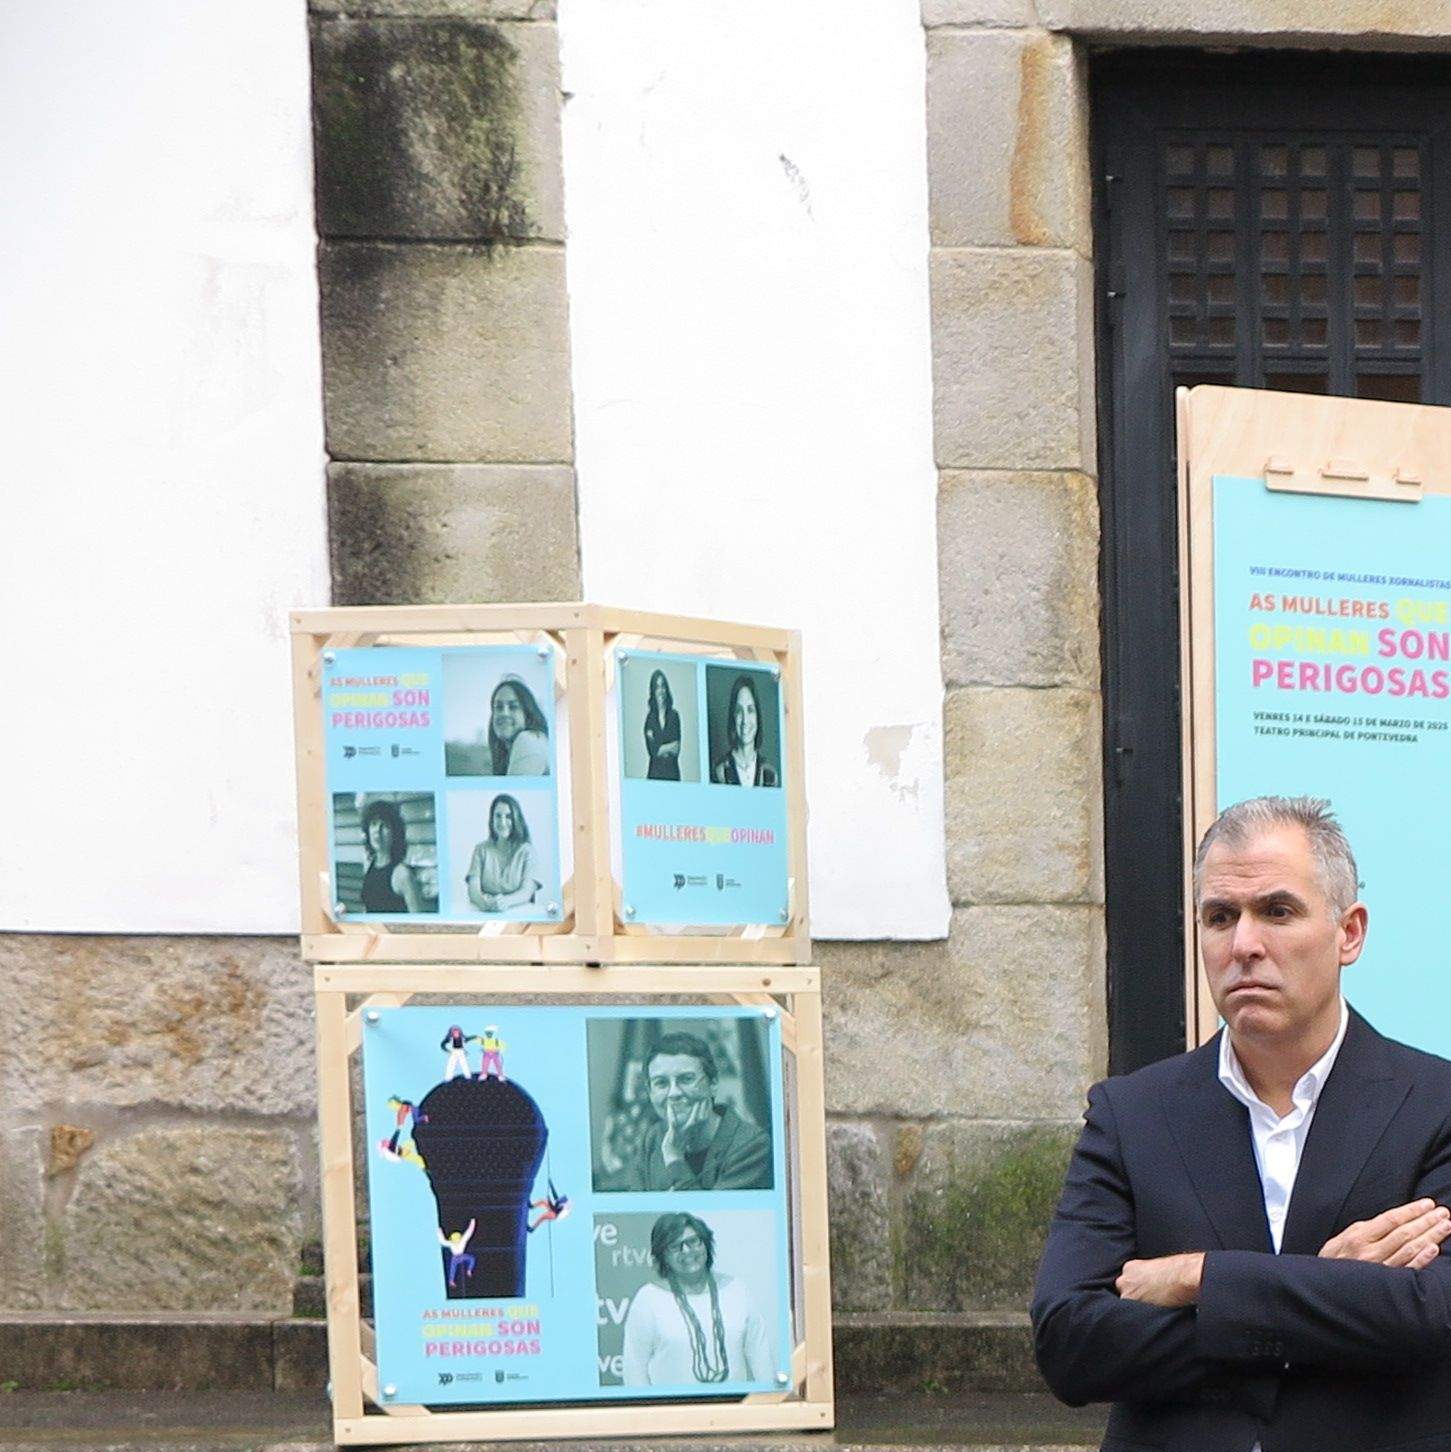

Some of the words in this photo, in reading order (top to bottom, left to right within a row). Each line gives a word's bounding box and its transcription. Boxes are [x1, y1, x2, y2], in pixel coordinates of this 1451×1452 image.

[1268, 567, 1321, 580] ENCONTRO
[1323, 571, 1335, 581] DE
[1337, 573, 1387, 585] MULLERES
[1389, 576, 1451, 590] XORNALISTAS
[1250, 593, 1276, 612] AS
[1281, 595, 1390, 620] MULLERES
[1397, 598, 1449, 627] QUE
[1250, 623, 1370, 657] OPINAN
[1377, 627, 1450, 662] SON
[1252, 659, 1450, 699] PERIGOSAS
[393, 689, 430, 706] SON
[332, 711, 430, 728] PERIGOSAS
[1253, 711, 1290, 722] VENRES
[1292, 713, 1303, 722] 14
[1313, 713, 1350, 726] SÁBADO
[1366, 717, 1377, 727] DE
[1380, 719, 1411, 729] MARZO
[1413, 720, 1424, 729] DE
[1254, 726, 1291, 737] TEATRO
[1292, 728, 1340, 739] PRINCIPAL
[1343, 730, 1355, 740] DE
[1357, 731, 1418, 743] PONTEVEDRA
[498, 1319, 540, 1336] SON
[425, 1339, 541, 1358] PERIGOSAS
